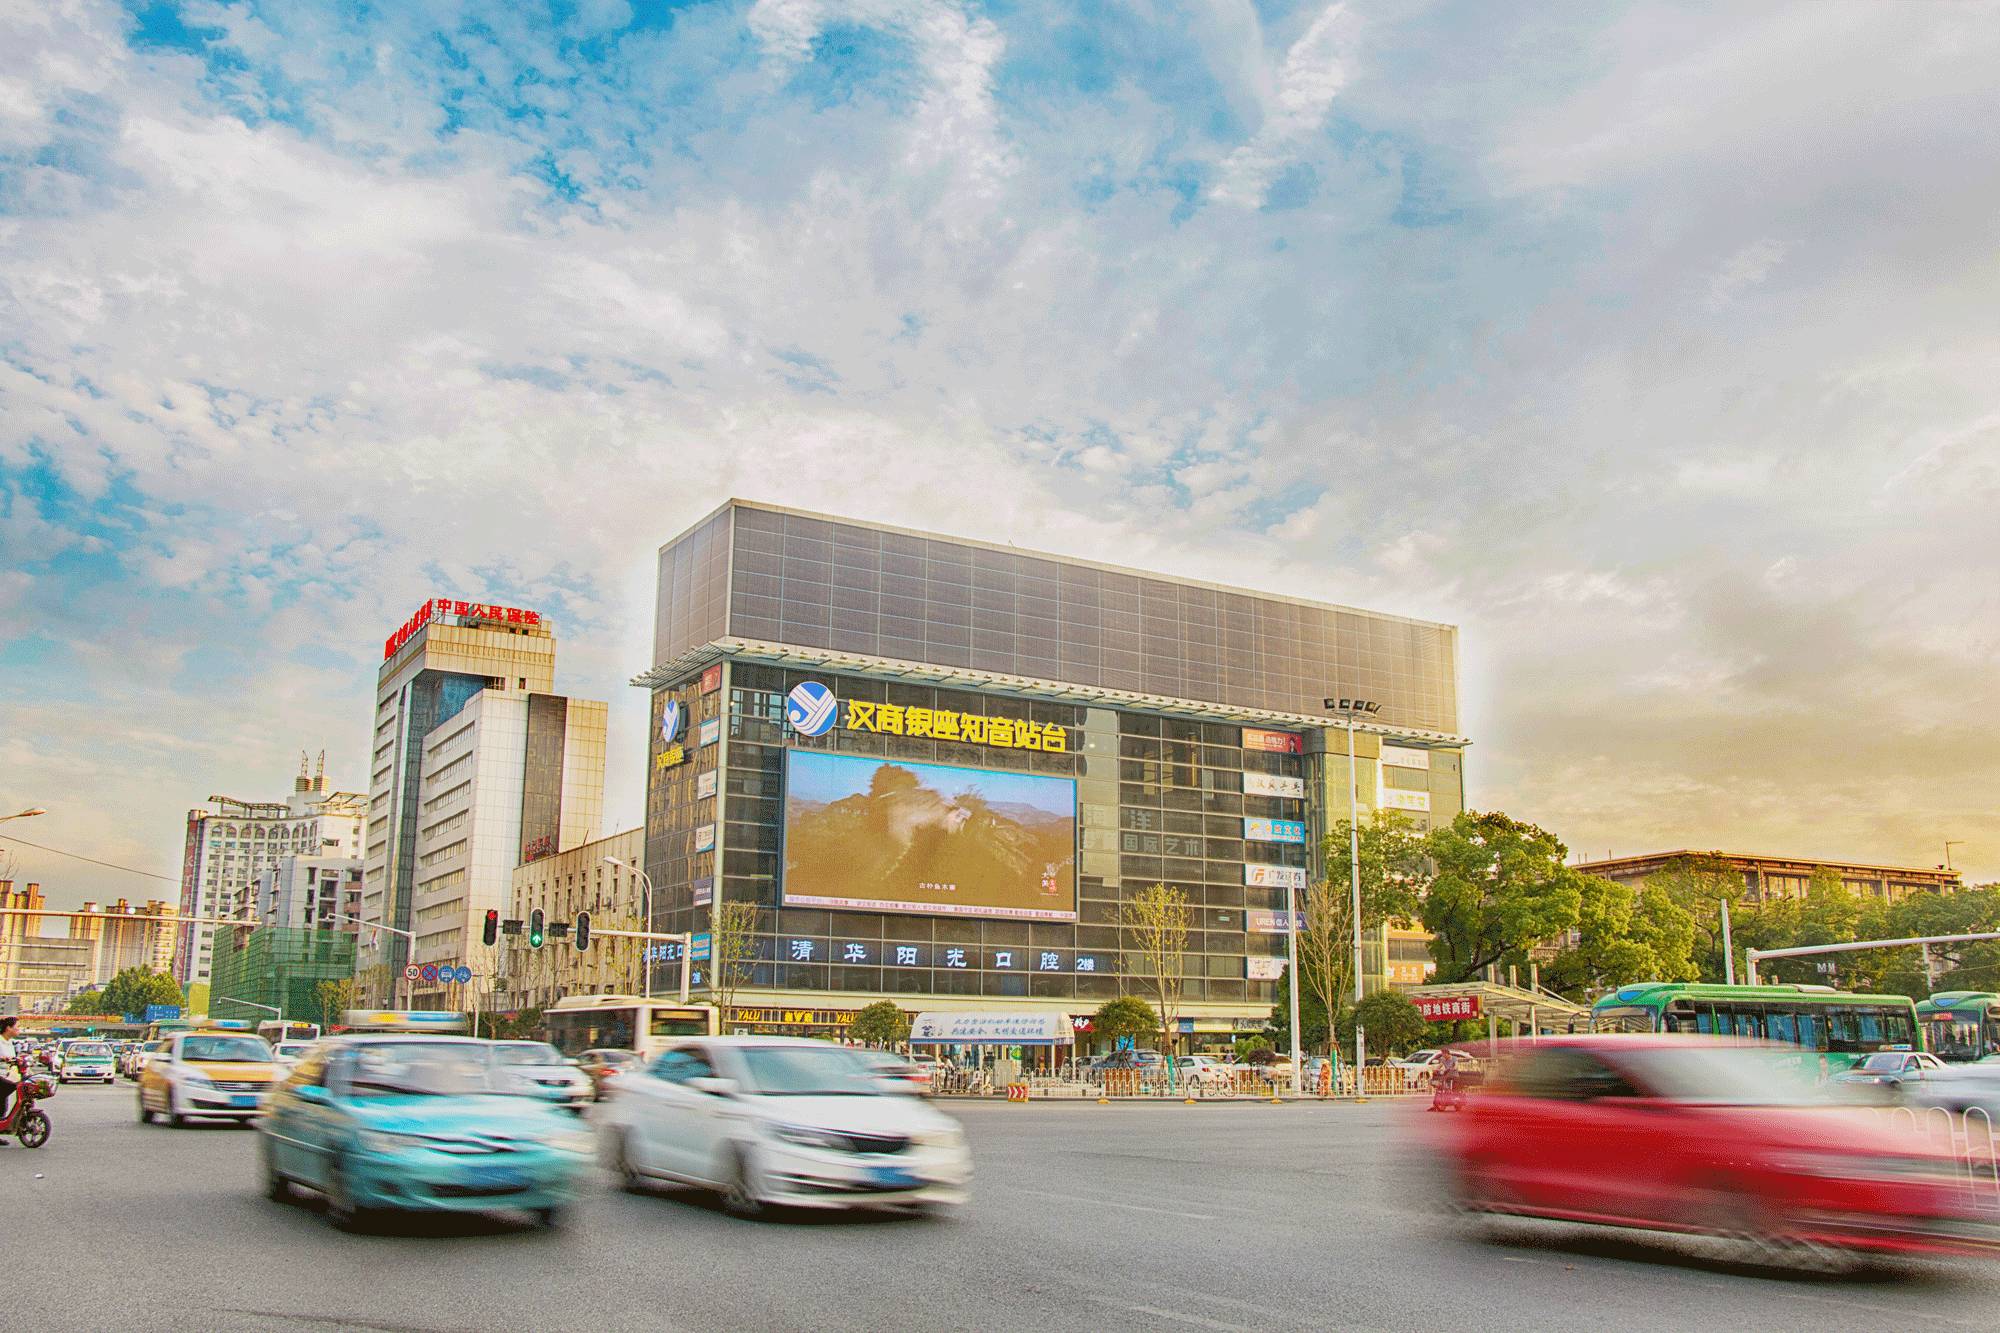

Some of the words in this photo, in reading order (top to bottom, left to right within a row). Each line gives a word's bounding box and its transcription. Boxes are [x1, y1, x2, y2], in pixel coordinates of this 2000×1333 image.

[437, 598, 541, 625] 中国人民保险
[847, 698, 1066, 752] 汉商银座知音站台
[791, 940, 1060, 970] 清华阳光口腔
[1076, 958, 1095, 972] 2楼
[407, 968, 418, 977] 50
[738, 1009, 761, 1021] YALU
